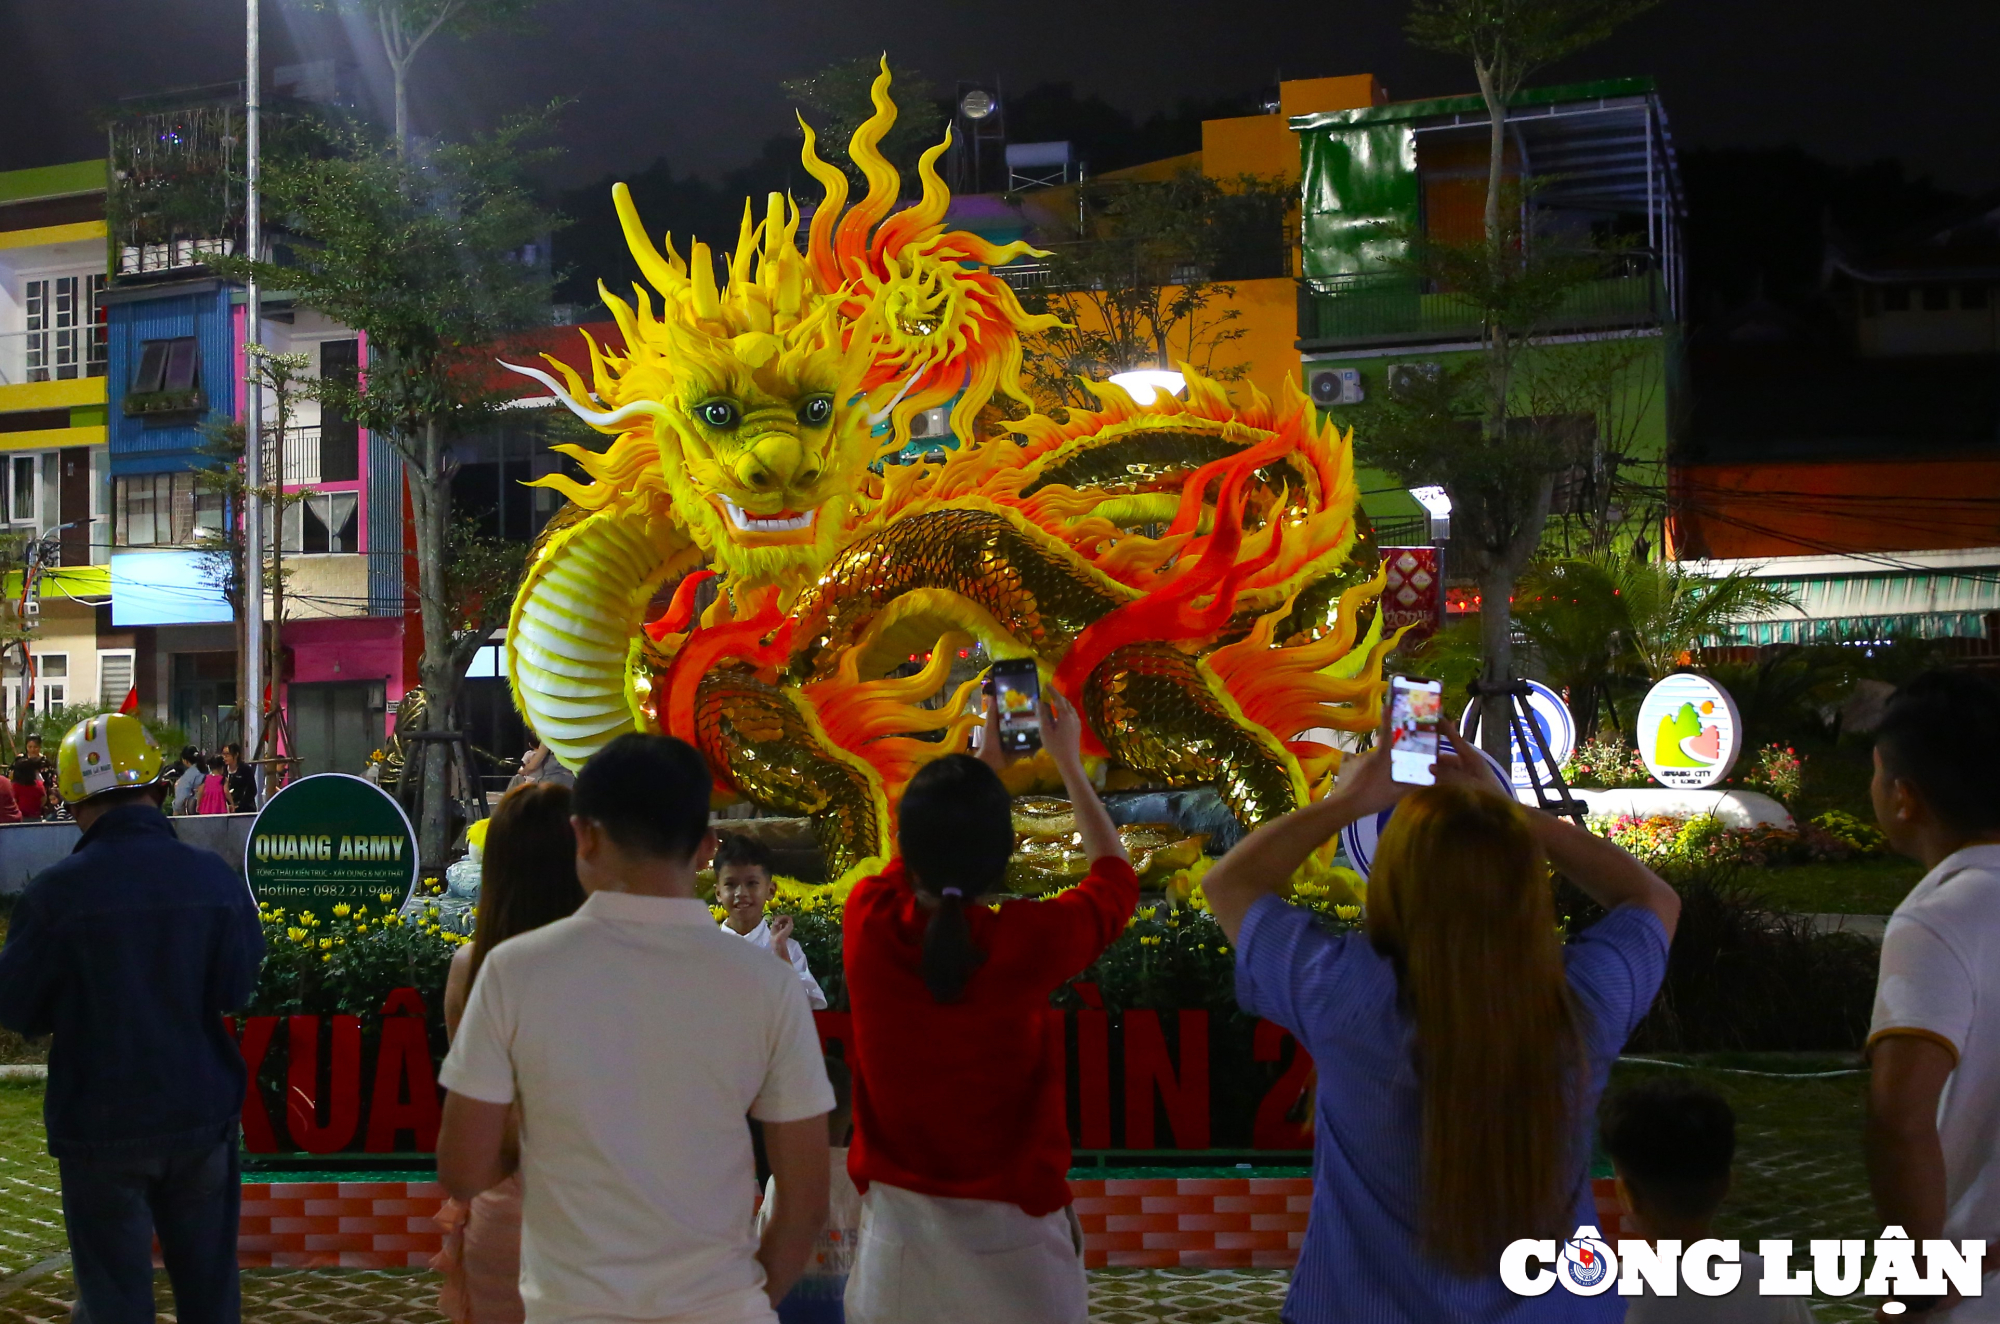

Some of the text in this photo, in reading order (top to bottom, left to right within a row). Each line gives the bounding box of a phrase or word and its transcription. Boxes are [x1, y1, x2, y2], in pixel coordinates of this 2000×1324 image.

[255, 834, 405, 863] QUANG ARMY
[258, 884, 310, 896] Hotline:
[222, 987, 444, 1153] XUÂ
